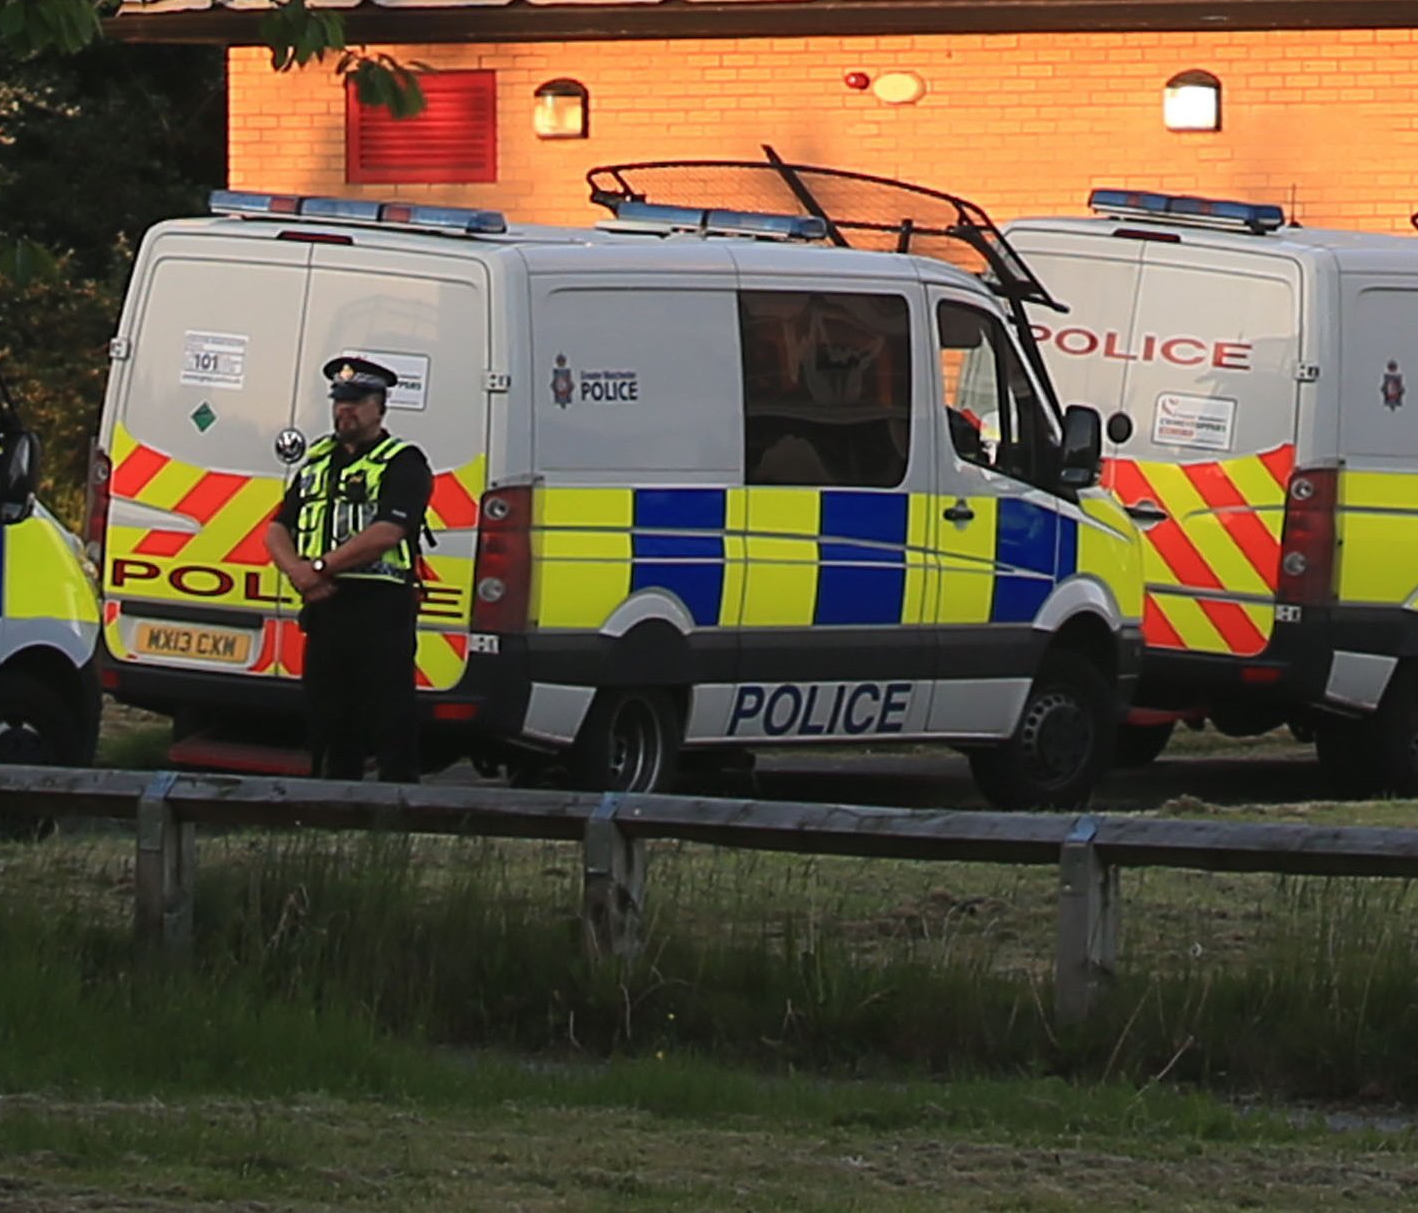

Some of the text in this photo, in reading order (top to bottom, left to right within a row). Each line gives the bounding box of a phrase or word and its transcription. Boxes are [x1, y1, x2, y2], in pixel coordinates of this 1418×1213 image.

[195, 353, 218, 371] 101
[1029, 324, 1253, 370] POLICE
[581, 381, 638, 401] POLICE
[112, 559, 463, 618] POLE
[147, 628, 191, 653] MX13
[726, 683, 912, 736] POLICE
